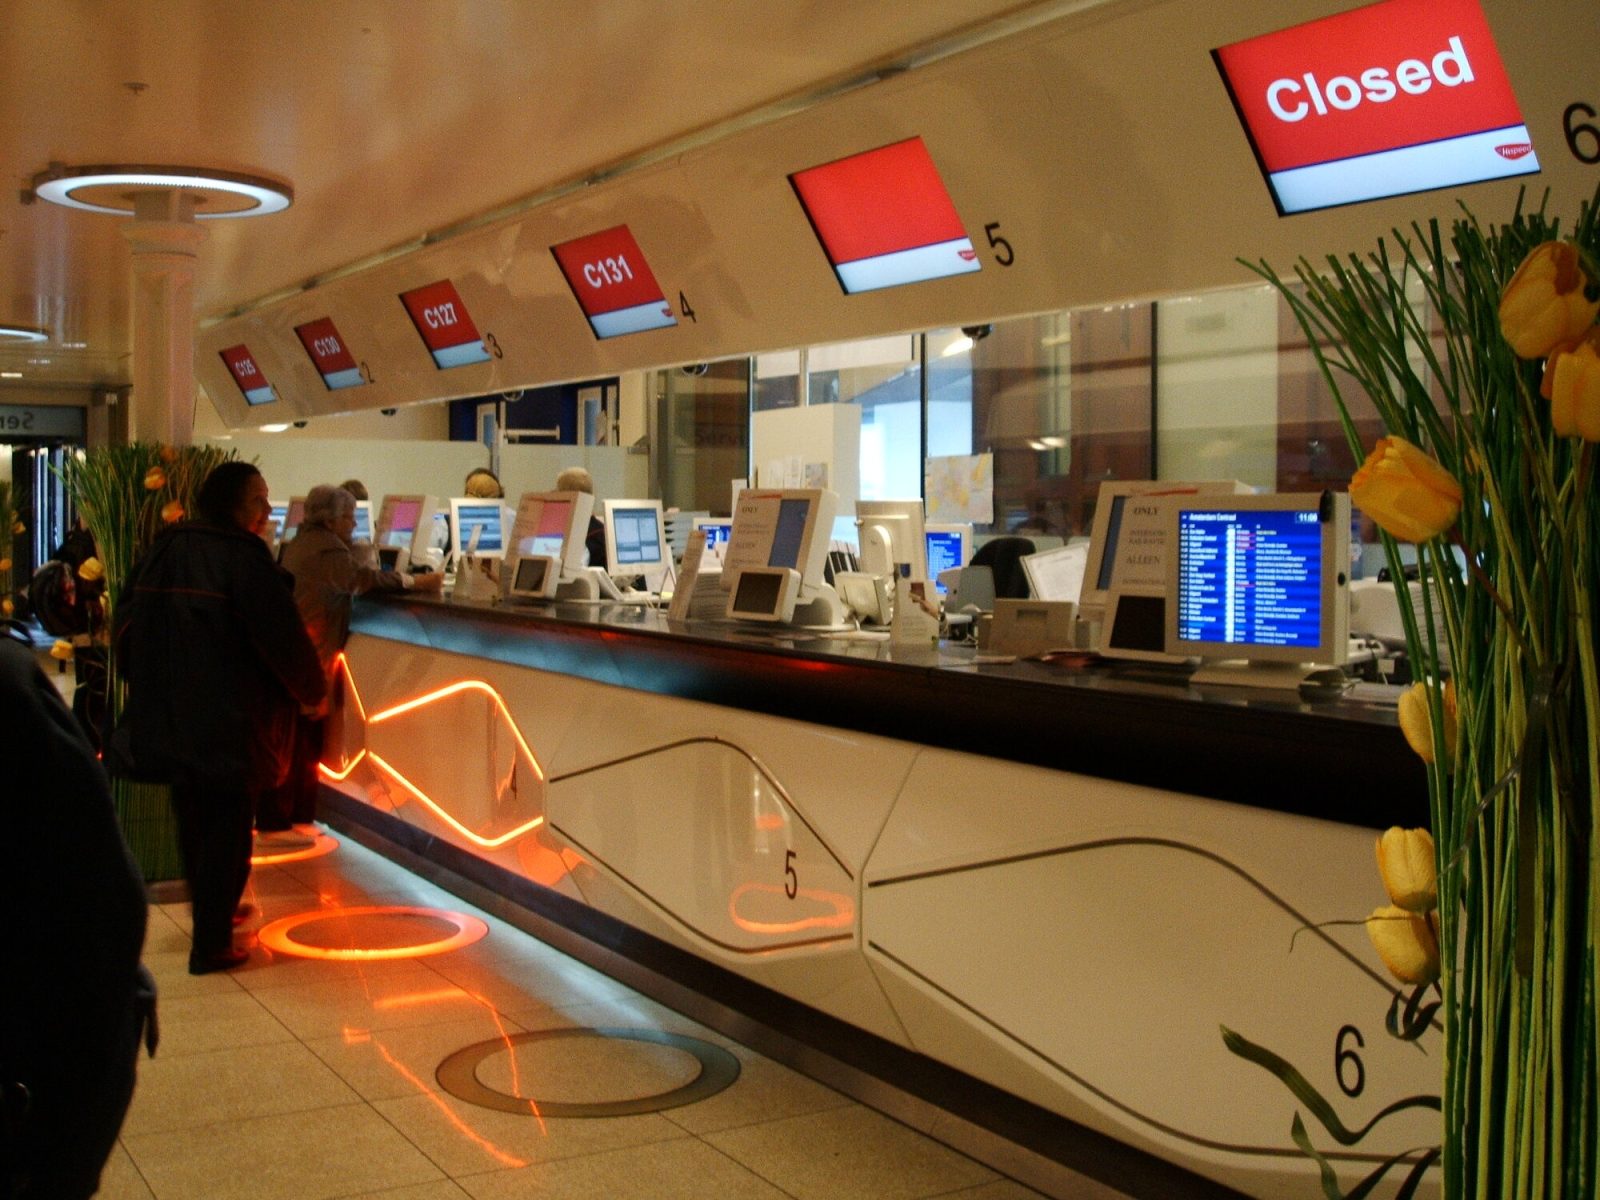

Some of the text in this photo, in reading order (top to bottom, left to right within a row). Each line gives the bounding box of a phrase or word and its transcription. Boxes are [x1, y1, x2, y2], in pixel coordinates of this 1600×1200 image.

[1266, 35, 1475, 122] Closed
[1563, 102, 1600, 165] 6
[984, 222, 1015, 267] 5
[583, 254, 634, 288] C131
[424, 302, 458, 329] C127
[679, 290, 697, 323] 4
[314, 336, 341, 356] C130
[487, 332, 504, 360] 3
[361, 361, 375, 383] 2
[785, 849, 797, 900] 5
[1335, 1024, 1365, 1098] 6
